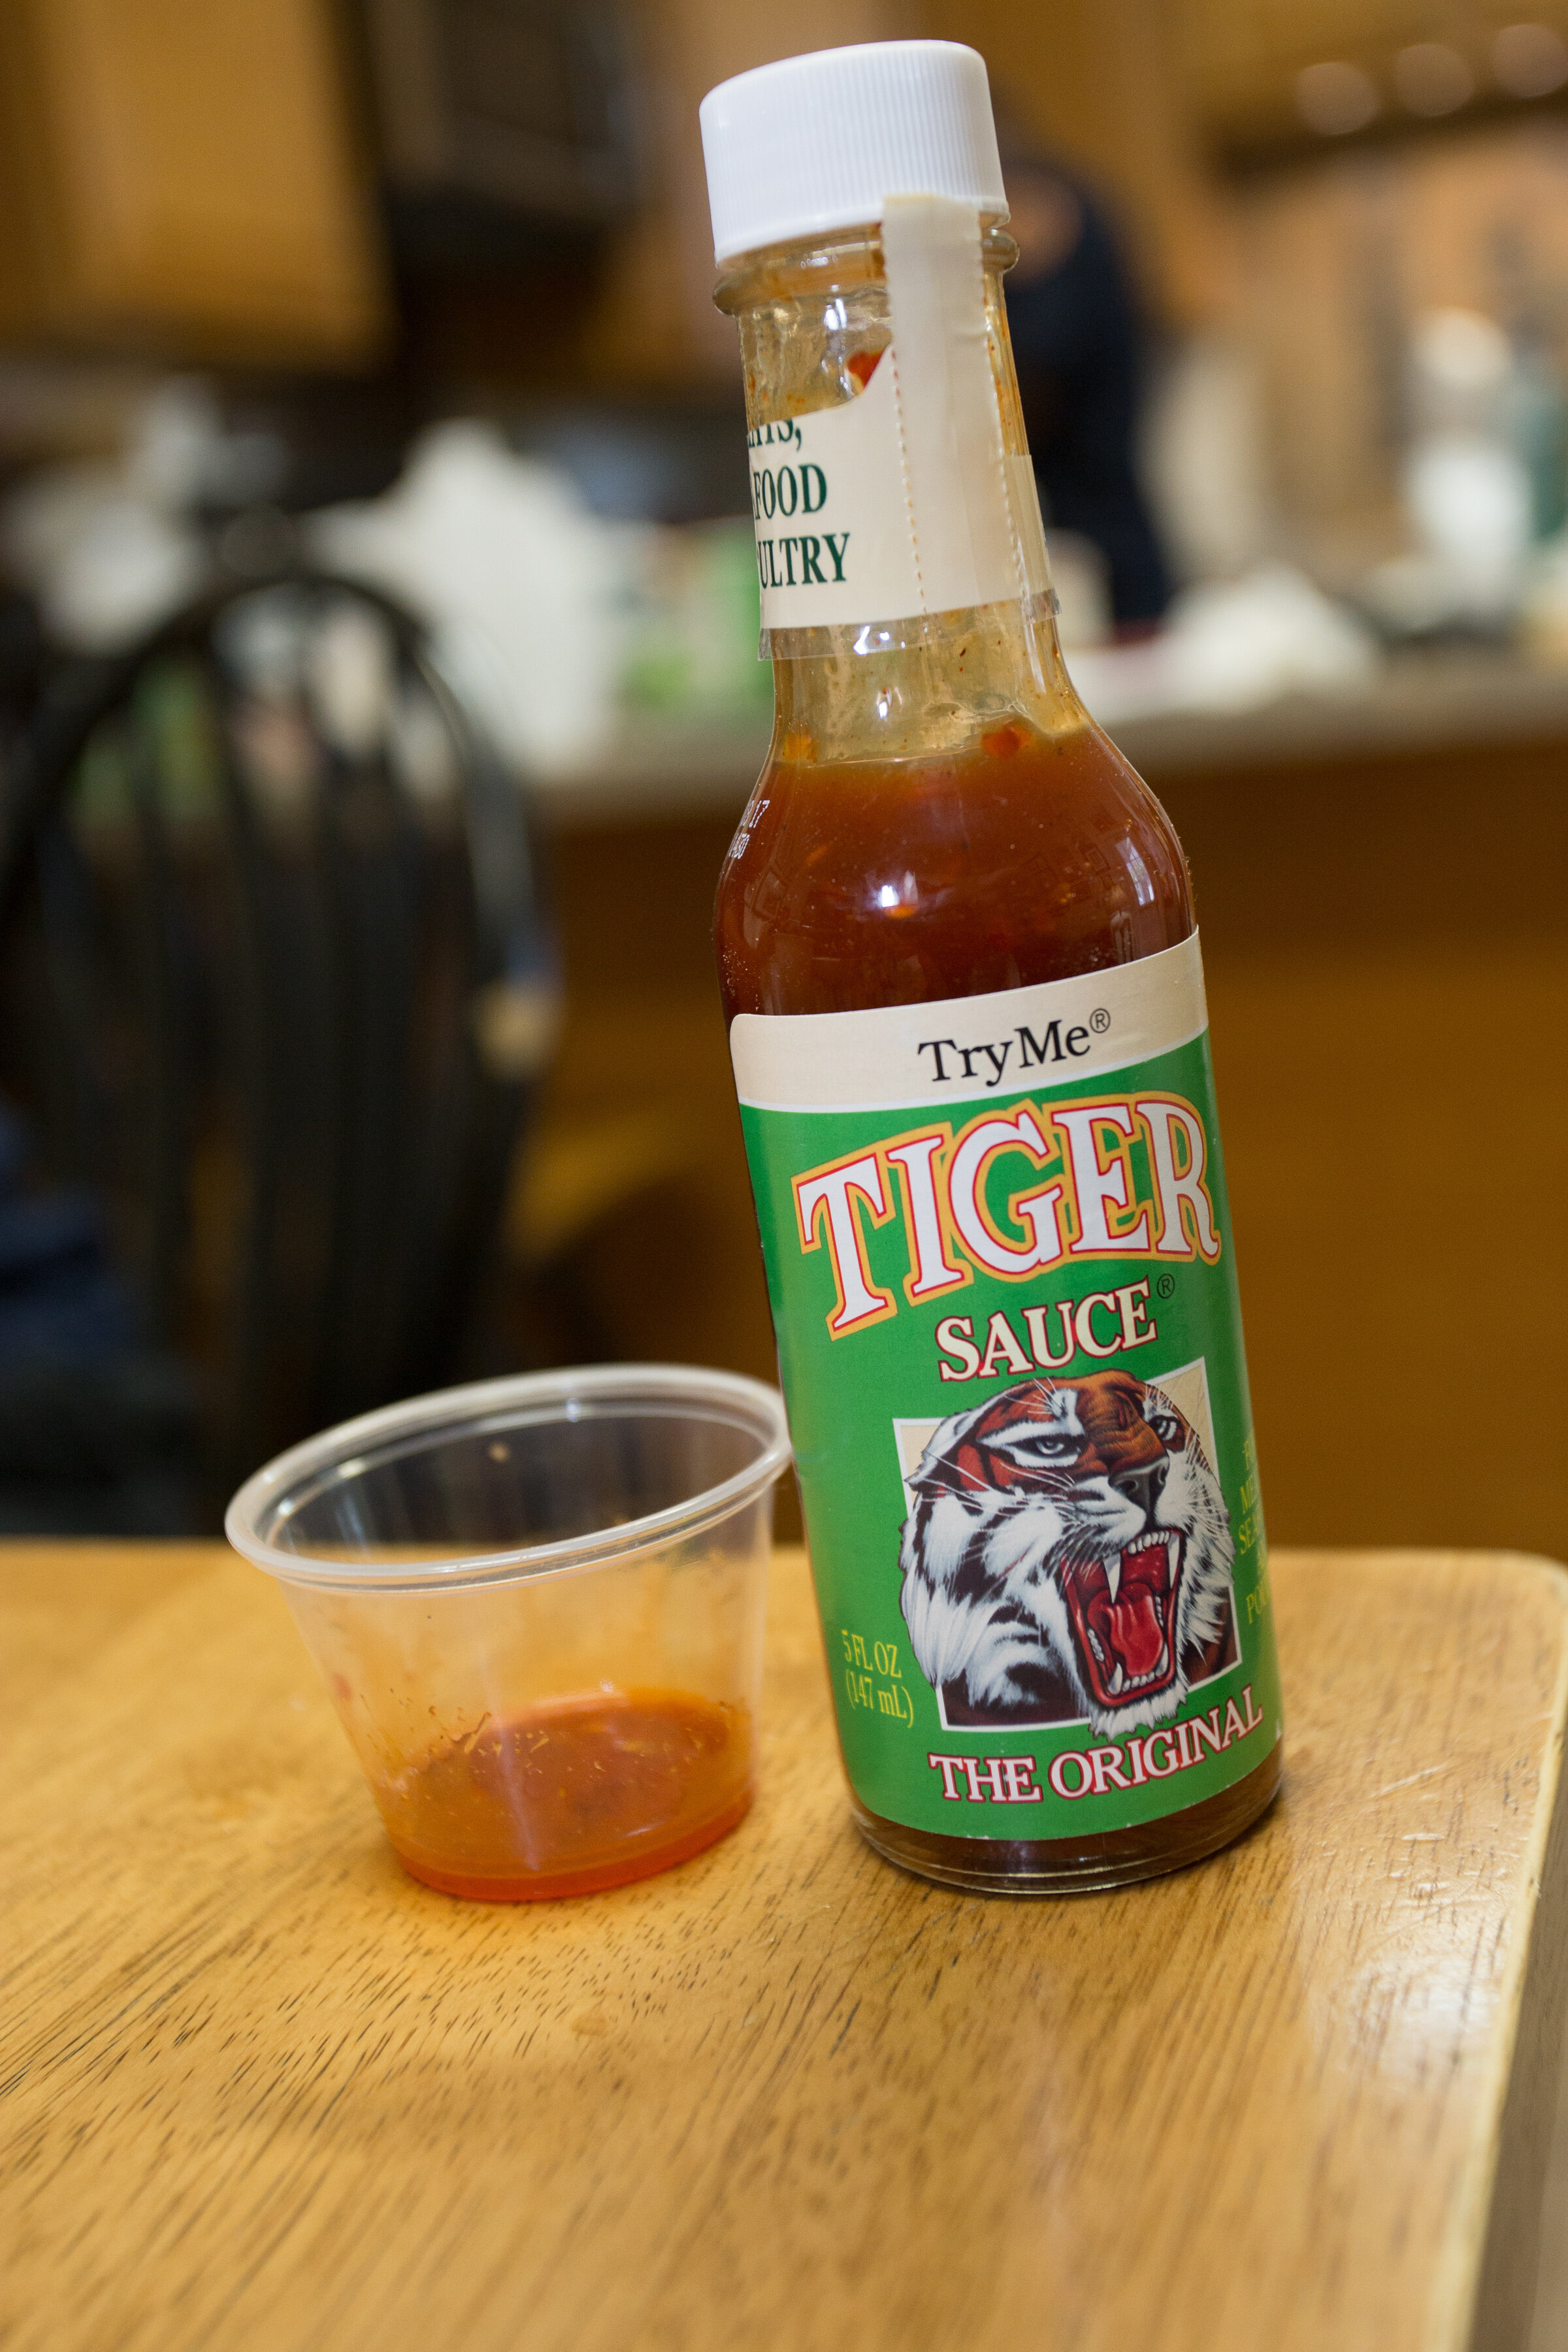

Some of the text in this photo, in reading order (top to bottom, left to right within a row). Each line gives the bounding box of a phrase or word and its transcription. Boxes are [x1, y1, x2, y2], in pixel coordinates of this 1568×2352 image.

[751, 463, 828, 520] FOOD
[757, 532, 851, 589] ULTRY
[791, 1090, 1221, 1341] TIGER
[841, 1629, 902, 1678] 5 FL OZ
[926, 1683, 1265, 1803] THE ORIGINAL
